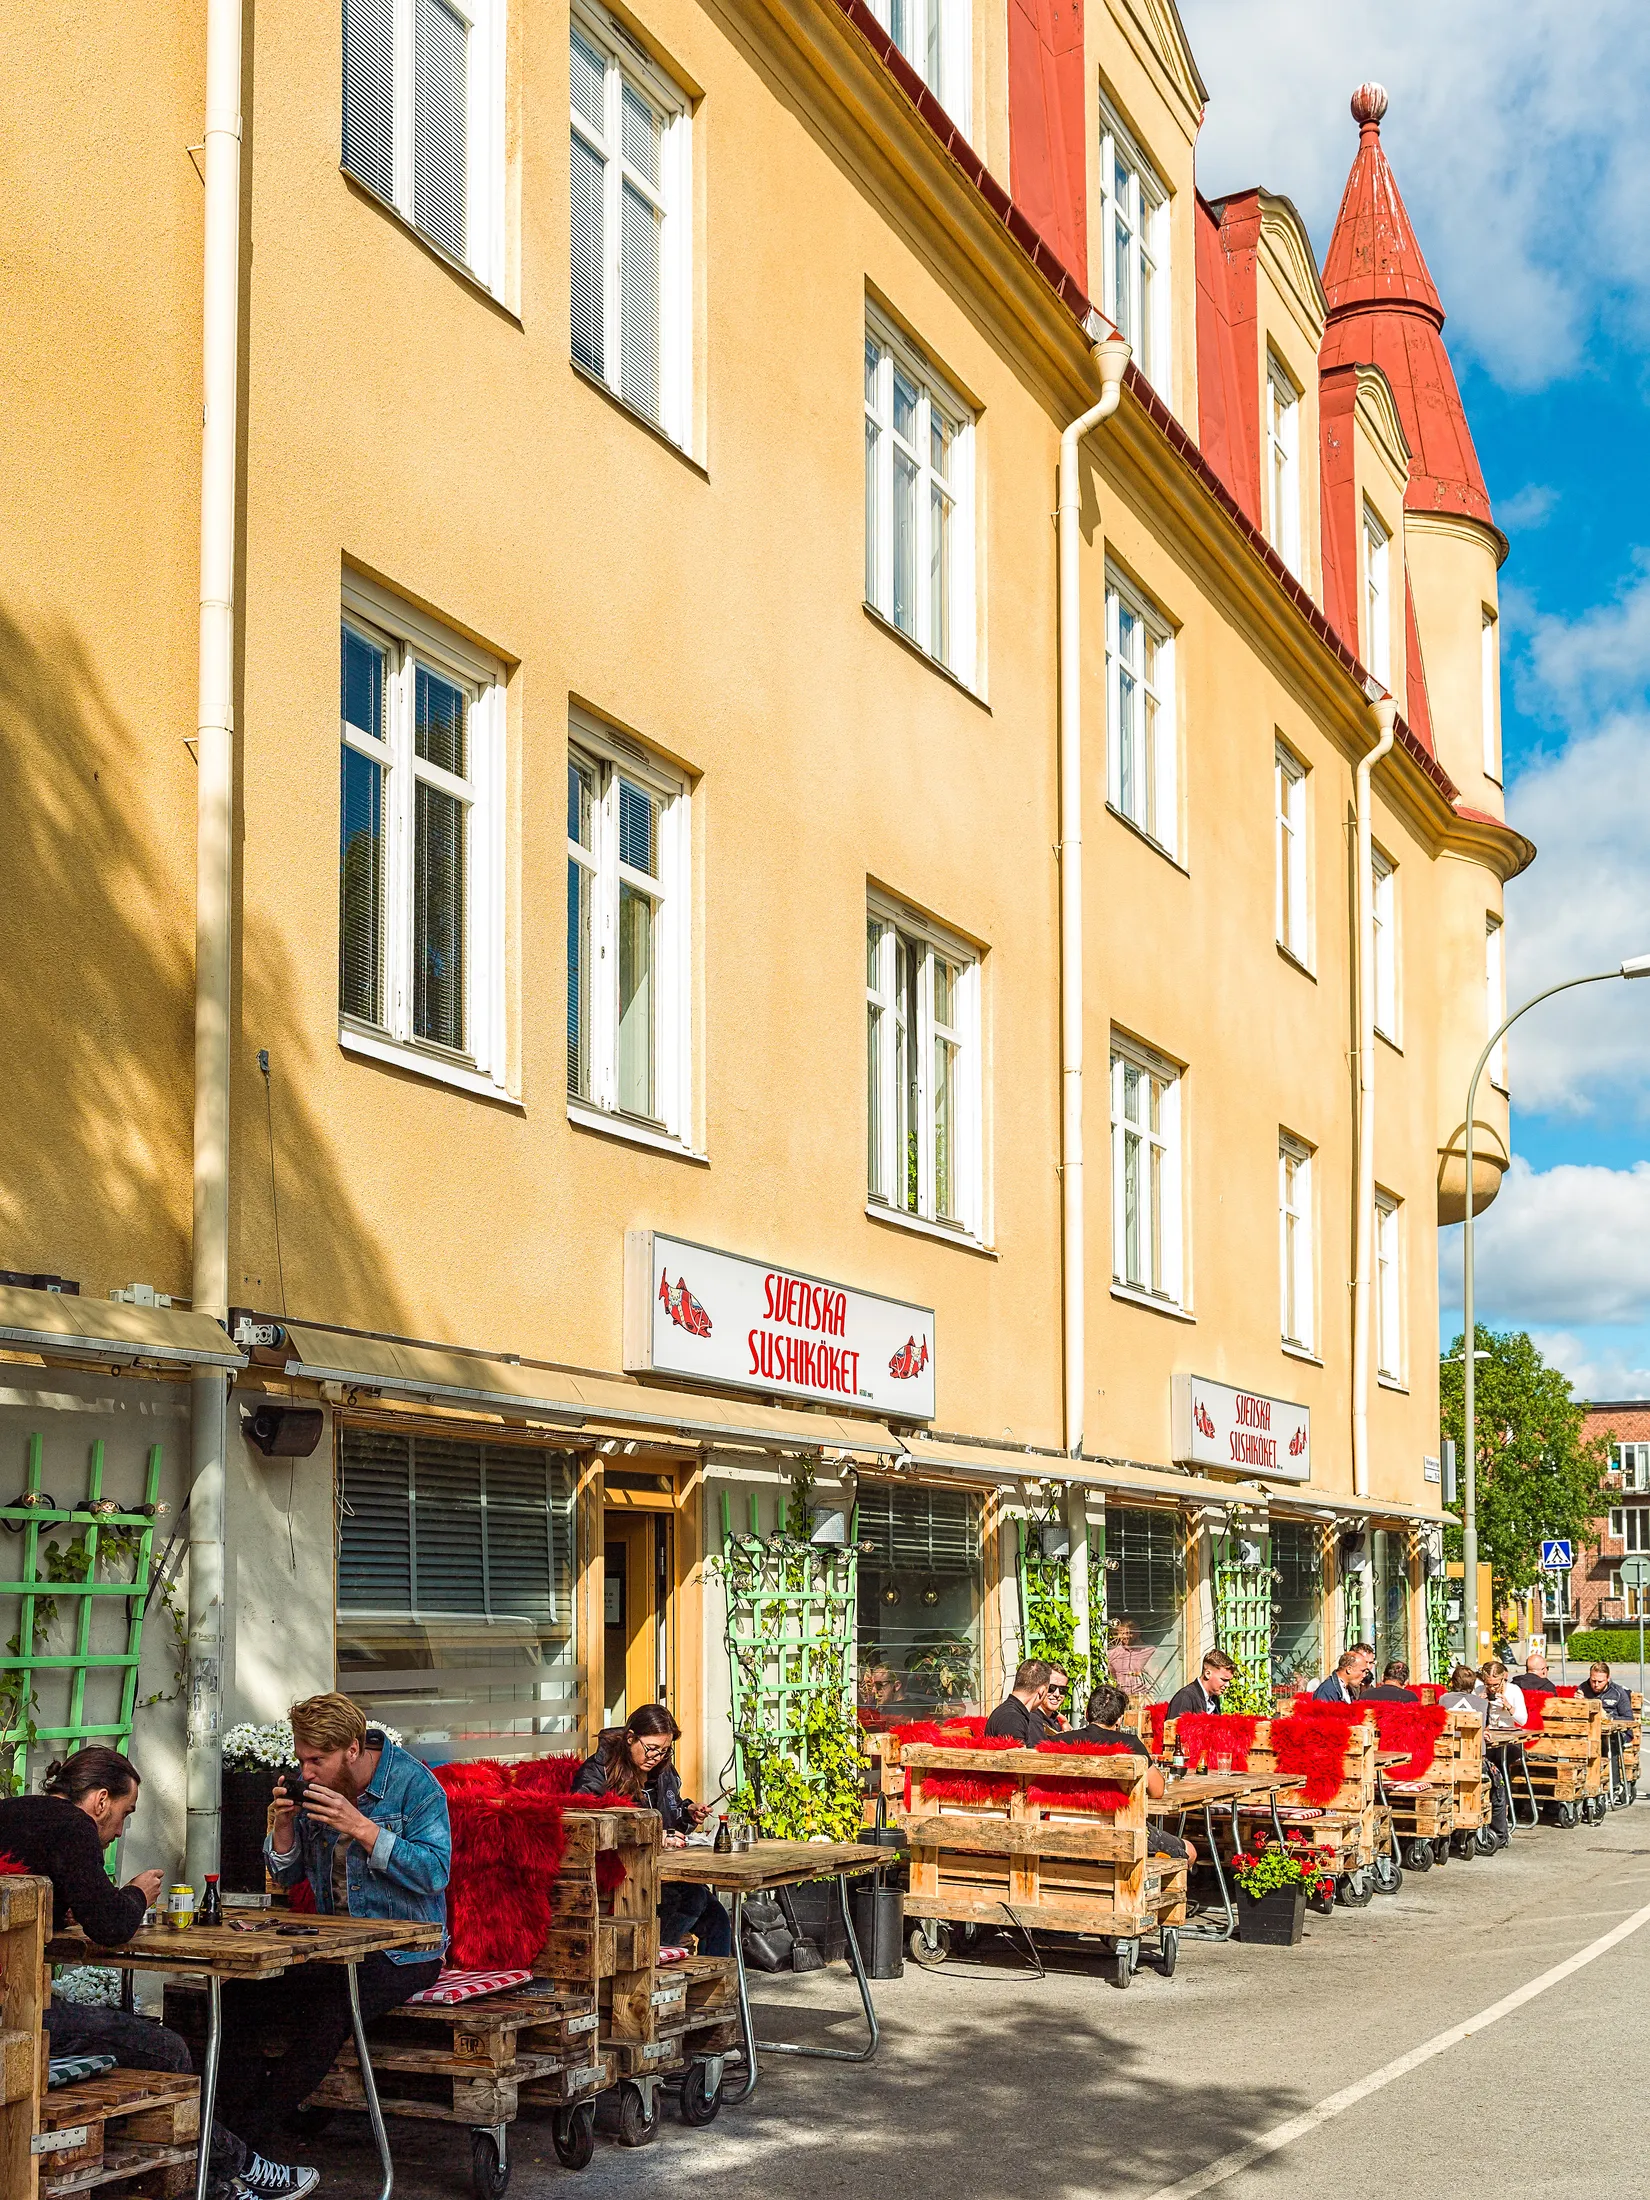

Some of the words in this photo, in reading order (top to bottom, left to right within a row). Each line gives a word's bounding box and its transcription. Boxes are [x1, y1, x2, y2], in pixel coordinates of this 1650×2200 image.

[763, 1273, 847, 1338] SVENSKA
[748, 1329, 860, 1395] SUSHIKÖKET
[1235, 1394, 1271, 1431] SVENSKA
[1230, 1431, 1277, 1469] SUSHIKÖKET
